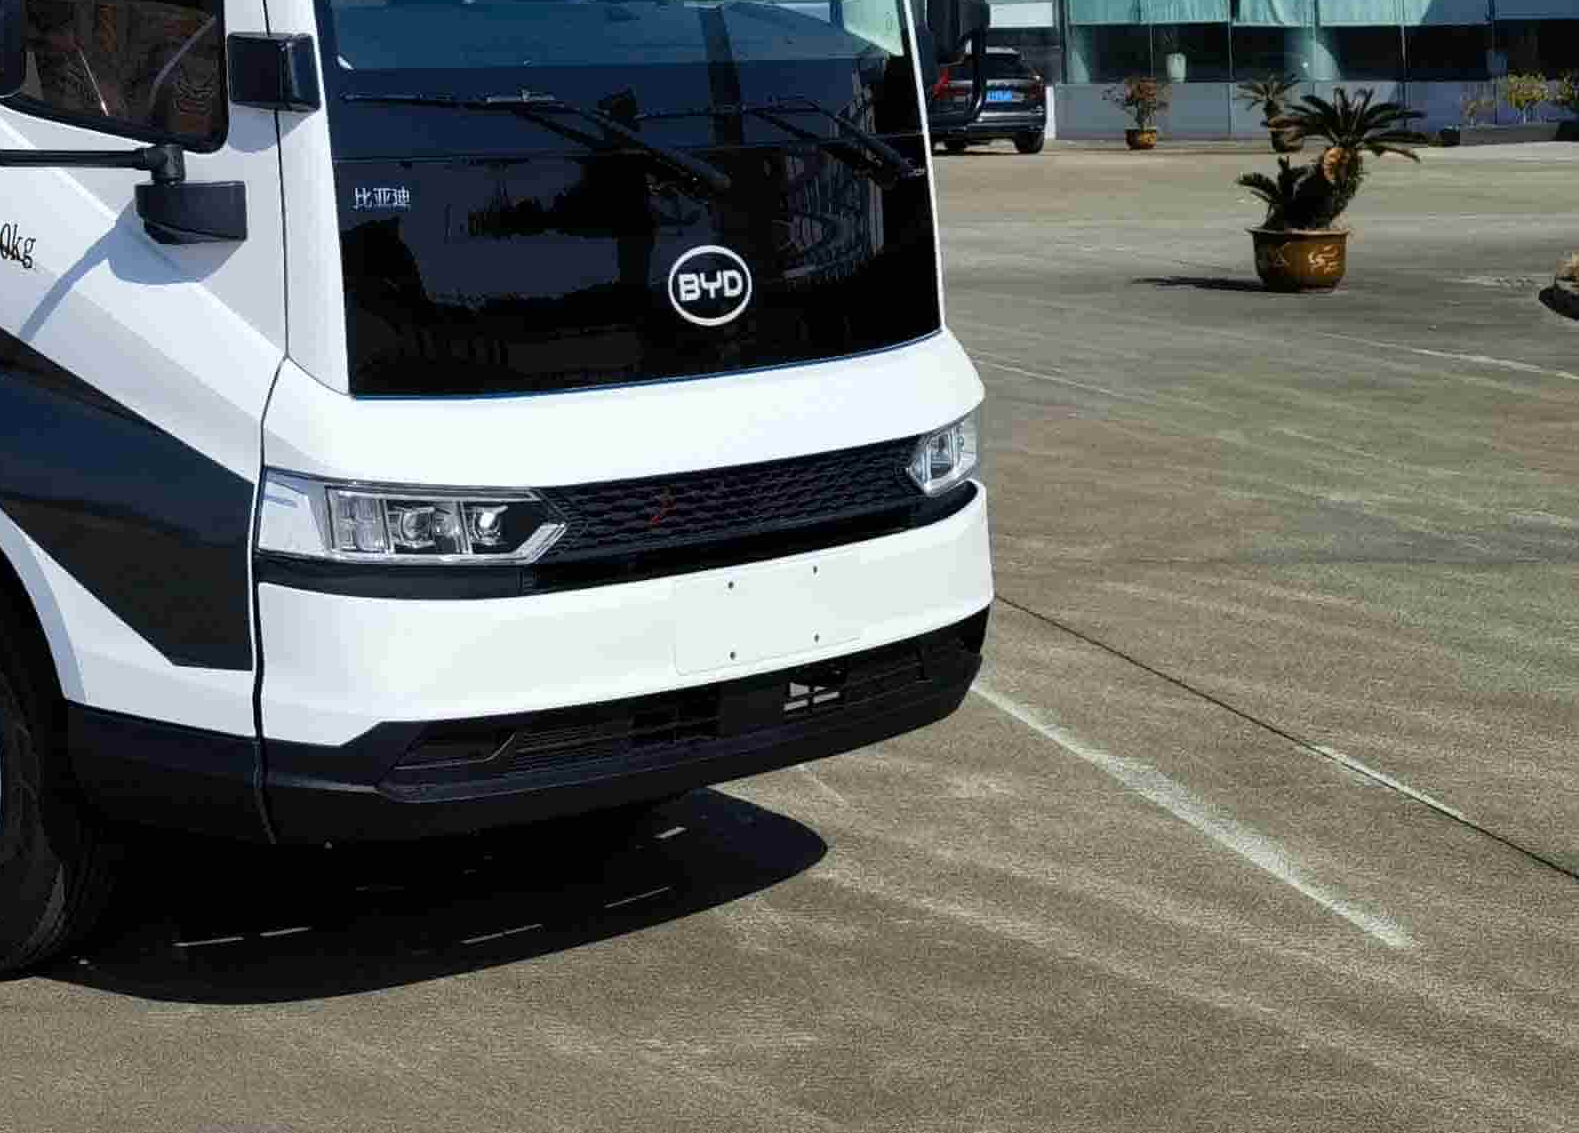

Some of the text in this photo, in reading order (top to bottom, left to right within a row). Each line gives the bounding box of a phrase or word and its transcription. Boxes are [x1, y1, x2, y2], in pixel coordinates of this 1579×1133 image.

[355, 186, 410, 208] 比亚迪
[679, 270, 742, 301] BYD
